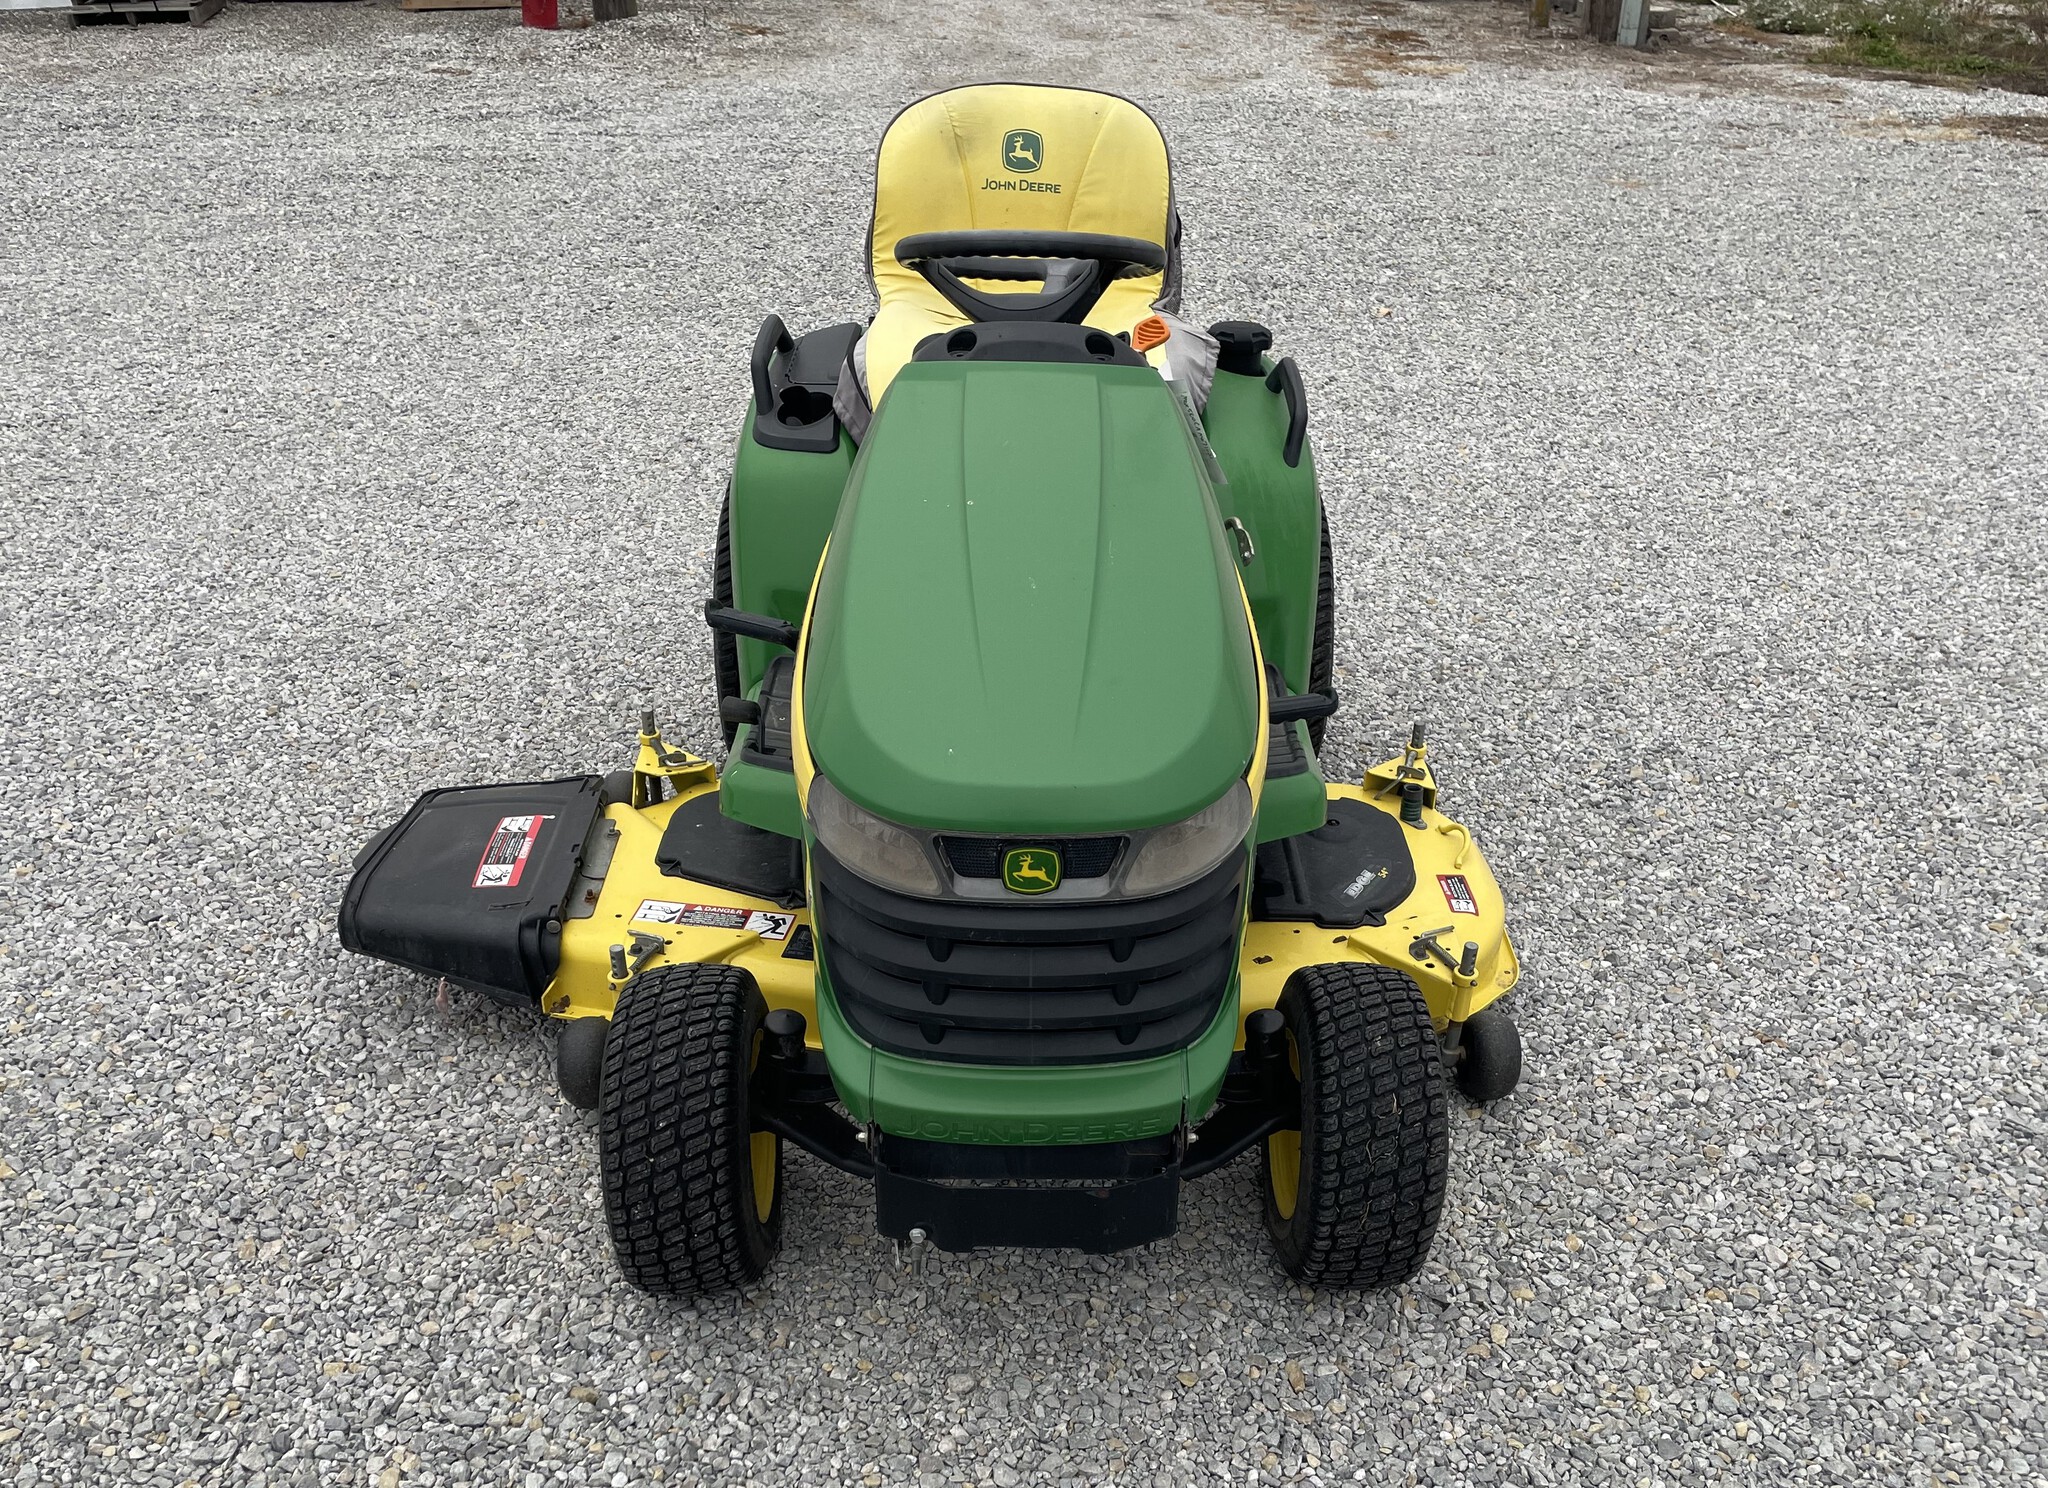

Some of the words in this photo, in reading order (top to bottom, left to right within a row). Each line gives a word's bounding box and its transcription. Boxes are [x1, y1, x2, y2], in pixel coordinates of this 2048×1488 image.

[981, 178, 1017, 191] JOHN
[1019, 179, 1062, 194] DEERE
[1343, 869, 1377, 900] EDGE
[703, 906, 744, 915] DANGER
[896, 1112, 1010, 1143] JOHN
[1022, 1118, 1162, 1144] DEERE
